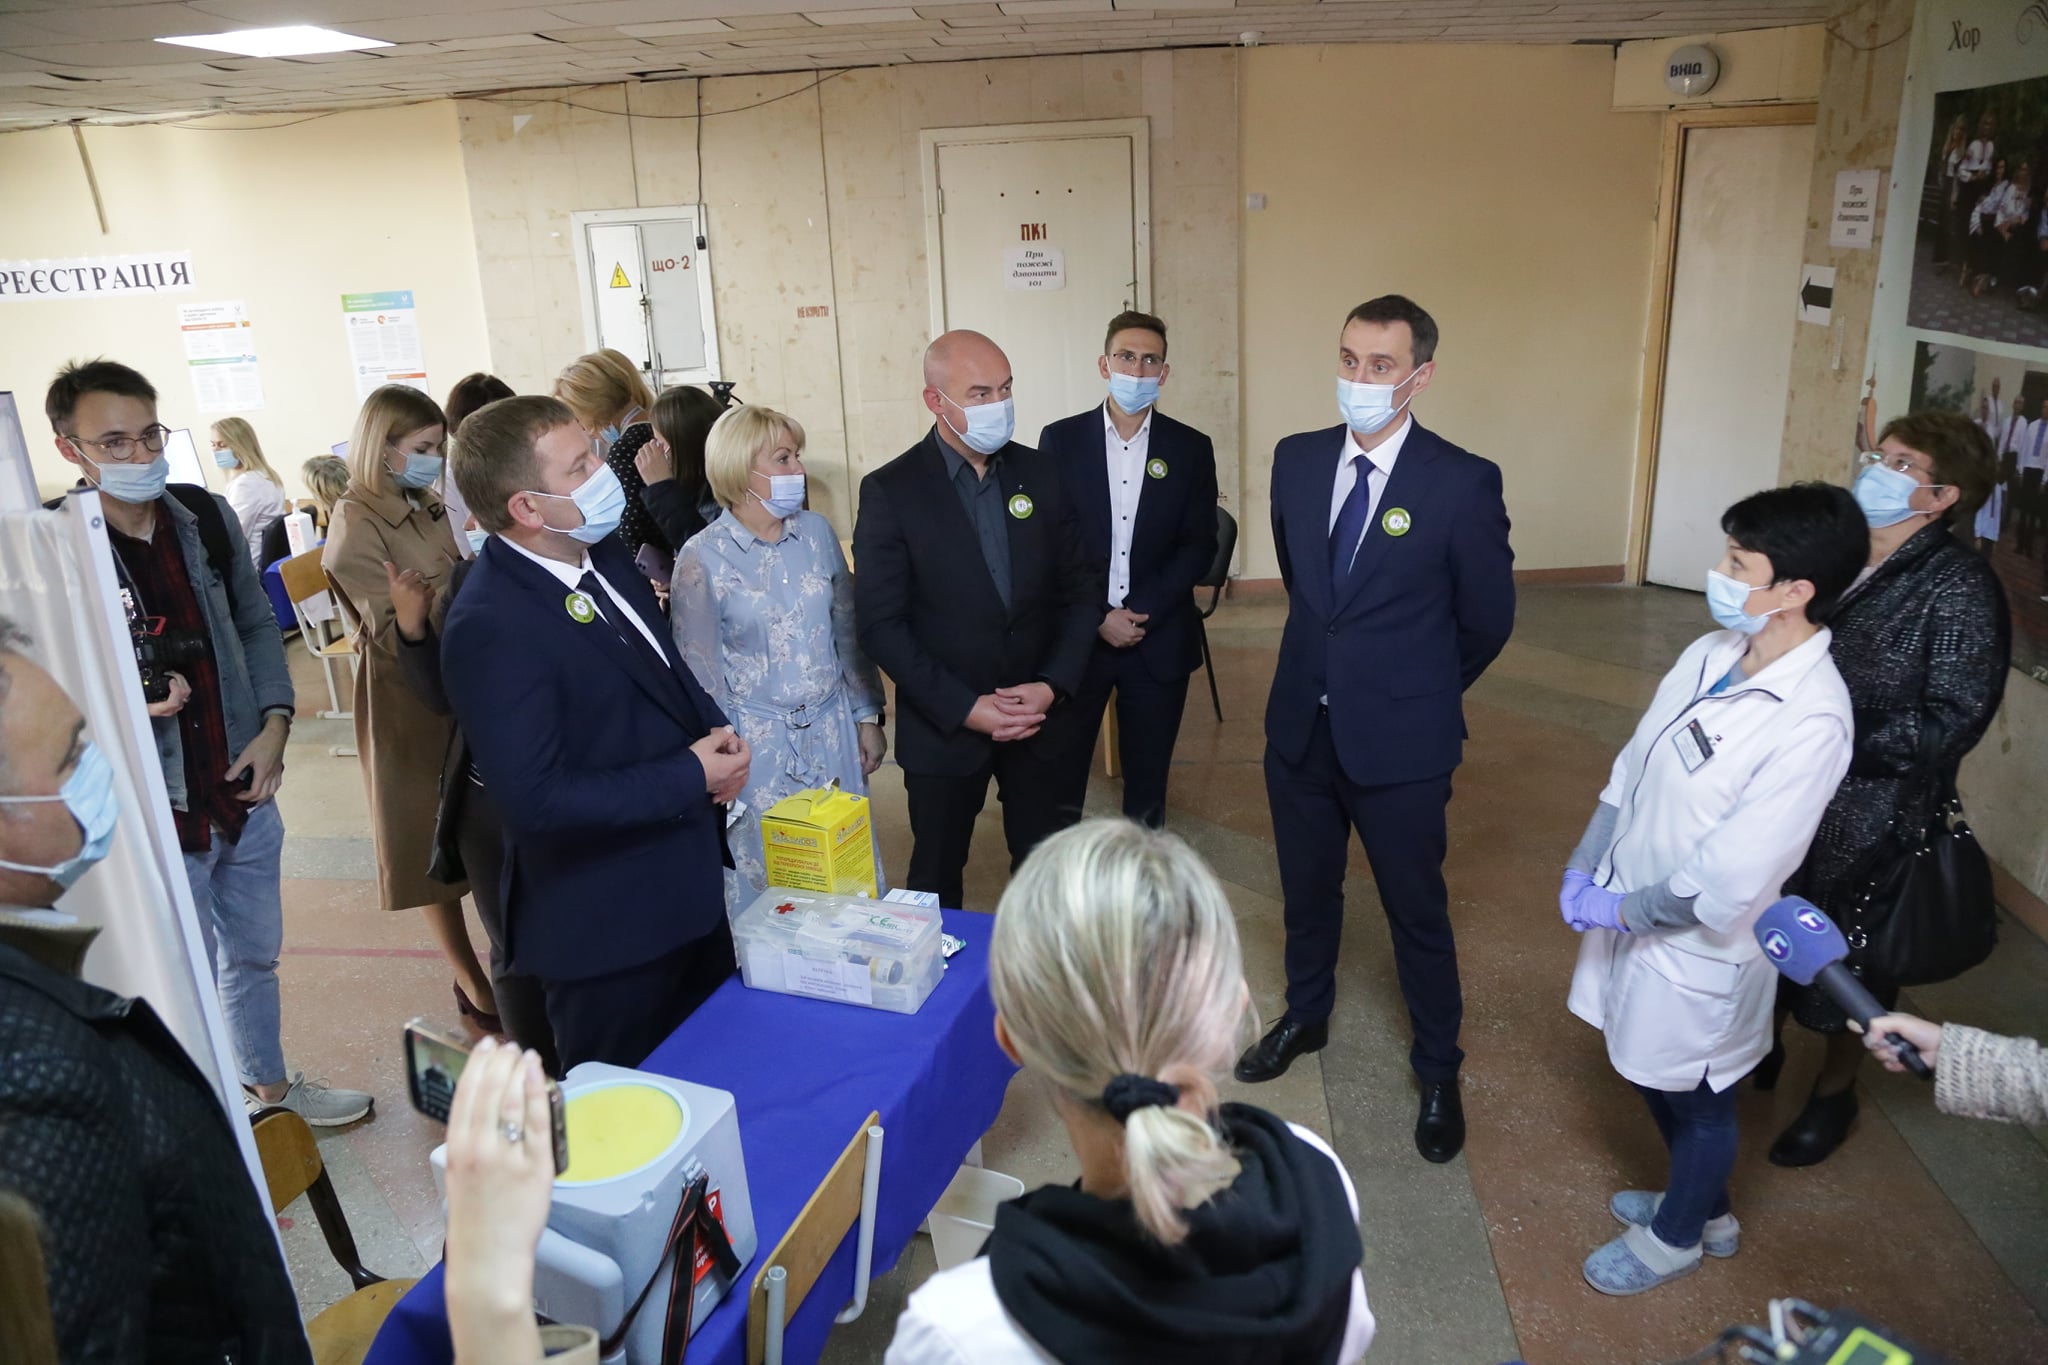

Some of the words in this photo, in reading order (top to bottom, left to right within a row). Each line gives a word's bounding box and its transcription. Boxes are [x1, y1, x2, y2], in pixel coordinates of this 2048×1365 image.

[1948, 20, 1981, 53] Хор
[1025, 250, 1044, 259] При
[652, 255, 690, 272] ЩО-2
[1016, 259, 1053, 268] пожежі
[0, 261, 191, 296] РЕЄСТРАЦІЯ
[1012, 270, 1057, 278] дзвонити
